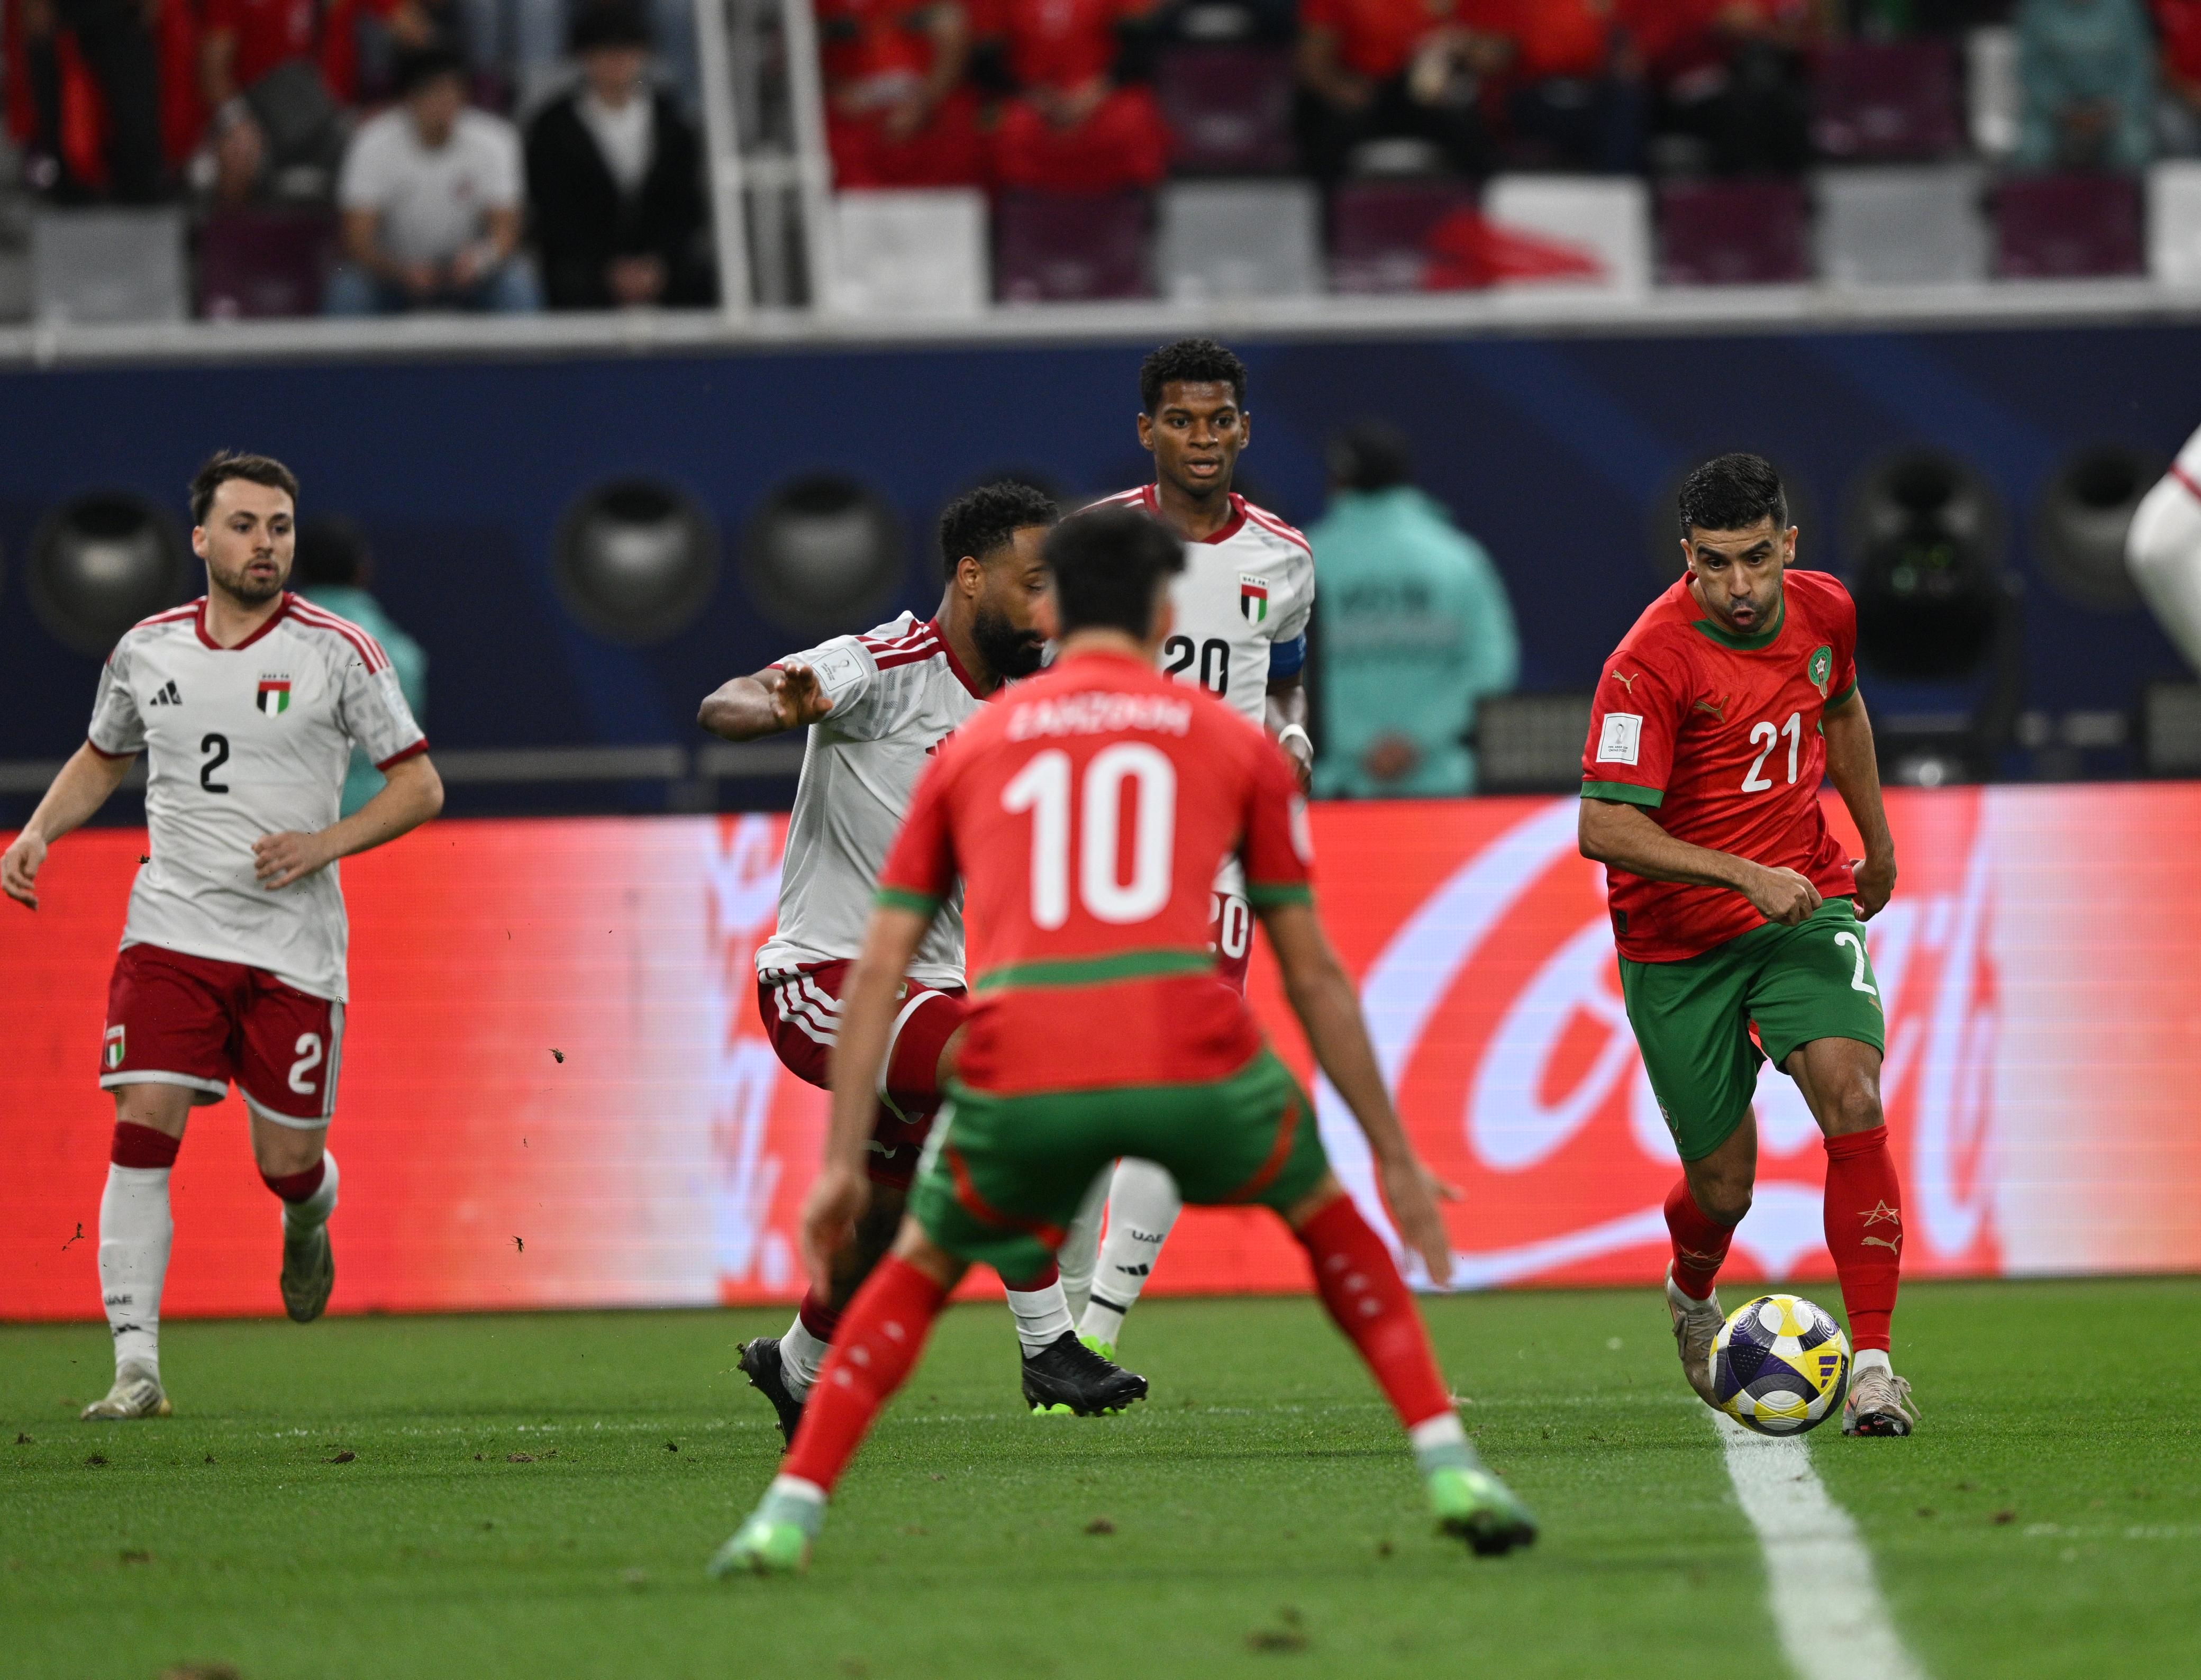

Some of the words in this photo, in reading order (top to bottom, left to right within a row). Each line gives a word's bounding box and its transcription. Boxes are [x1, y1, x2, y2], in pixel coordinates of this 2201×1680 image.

[1163, 635, 1230, 701] 20
[201, 733, 230, 793] 2
[1741, 712, 1800, 793] 21
[1001, 741, 1177, 930] 10
[1834, 932, 1877, 995] 2
[288, 1033, 322, 1095] 2
